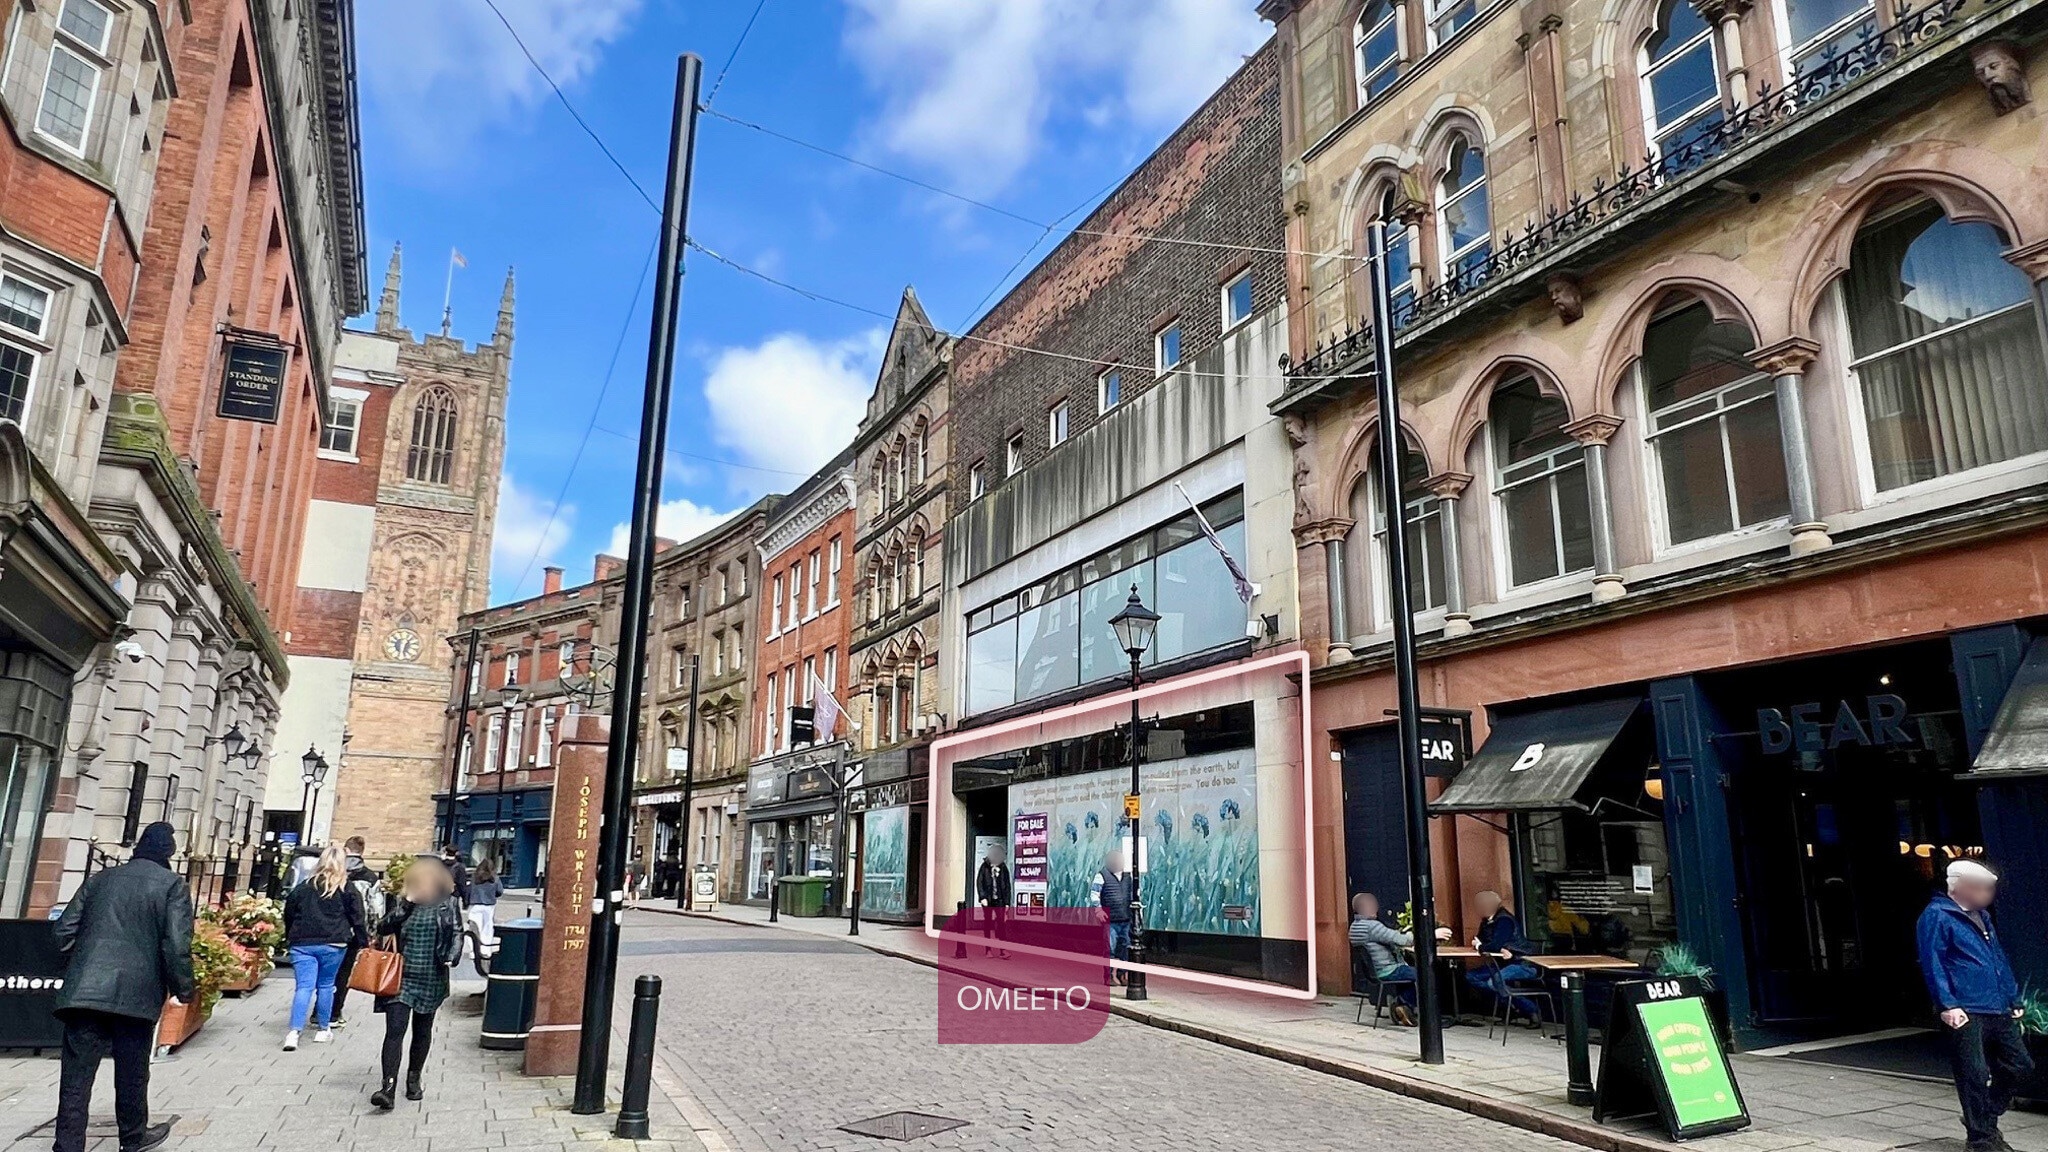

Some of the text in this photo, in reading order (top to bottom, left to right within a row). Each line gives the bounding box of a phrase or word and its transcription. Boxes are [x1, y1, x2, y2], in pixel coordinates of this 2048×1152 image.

[229, 371, 278, 384] STANDING
[236, 380, 268, 391] ORDER
[1757, 693, 1912, 755] BEAR
[1421, 738, 1454, 761] EAR
[1510, 743, 1545, 772] B
[1189, 764, 1201, 775] the
[1203, 762, 1225, 773] earth,
[1227, 760, 1240, 770] but
[1196, 779, 1210, 789] You
[1211, 775, 1221, 787] do
[1223, 777, 1238, 785] too.
[577, 775, 591, 840] JOSEPH
[1018, 819, 1044, 831] FOR SALE
[573, 849, 587, 915] WRIGHT
[565, 925, 585, 936] 1734
[563, 939, 584, 950] 1797
[1646, 980, 1682, 1000] BEAR
[1673, 1022, 1702, 1037] COFFEE
[1681, 1040, 1708, 1055] PEOPLE
